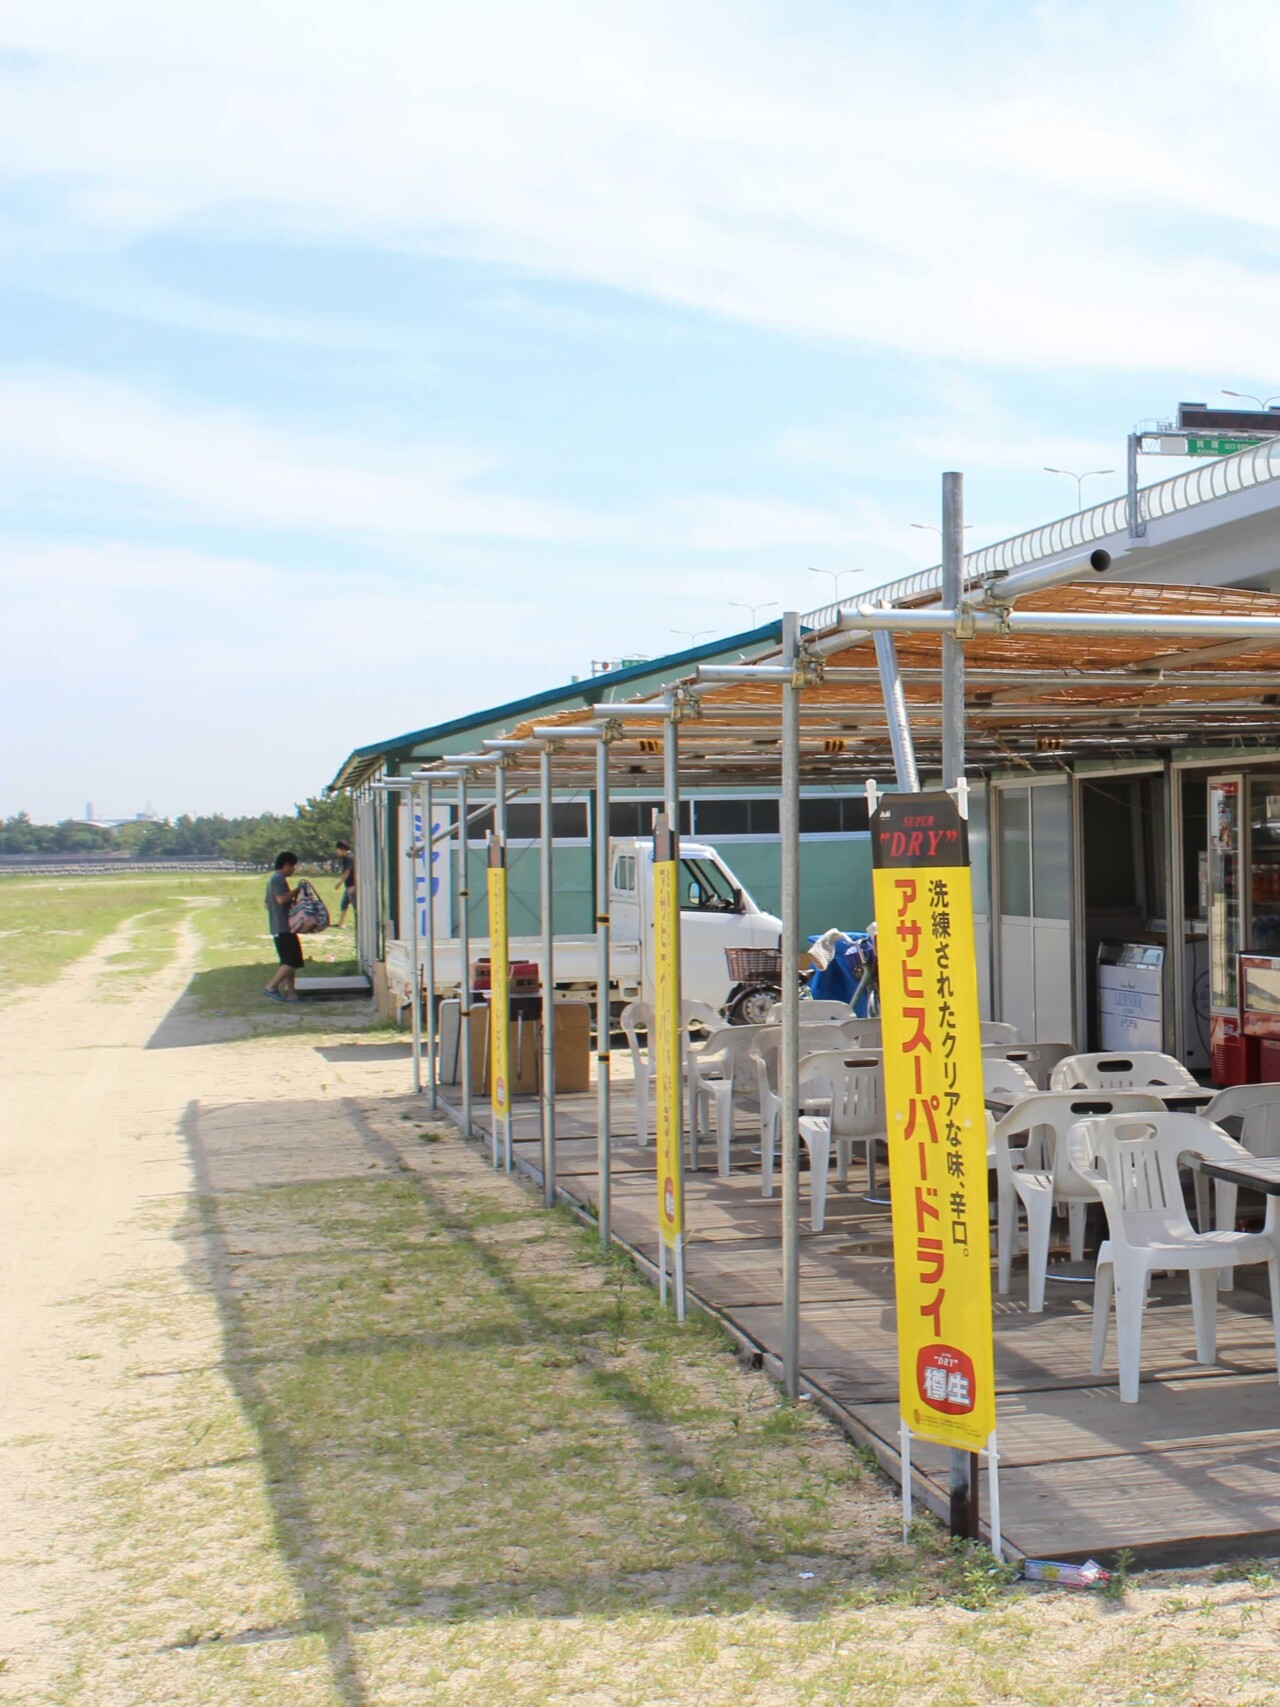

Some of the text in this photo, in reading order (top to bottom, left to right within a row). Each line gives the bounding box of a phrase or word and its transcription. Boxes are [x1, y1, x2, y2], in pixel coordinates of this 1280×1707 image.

[903, 815, 935, 828] SUPER
[894, 878, 946, 1338] アサヒスーパードライ
[928, 878, 969, 1258] 洗練されたクリアな味、辛口。
[923, 1366, 971, 1408] 樽生
